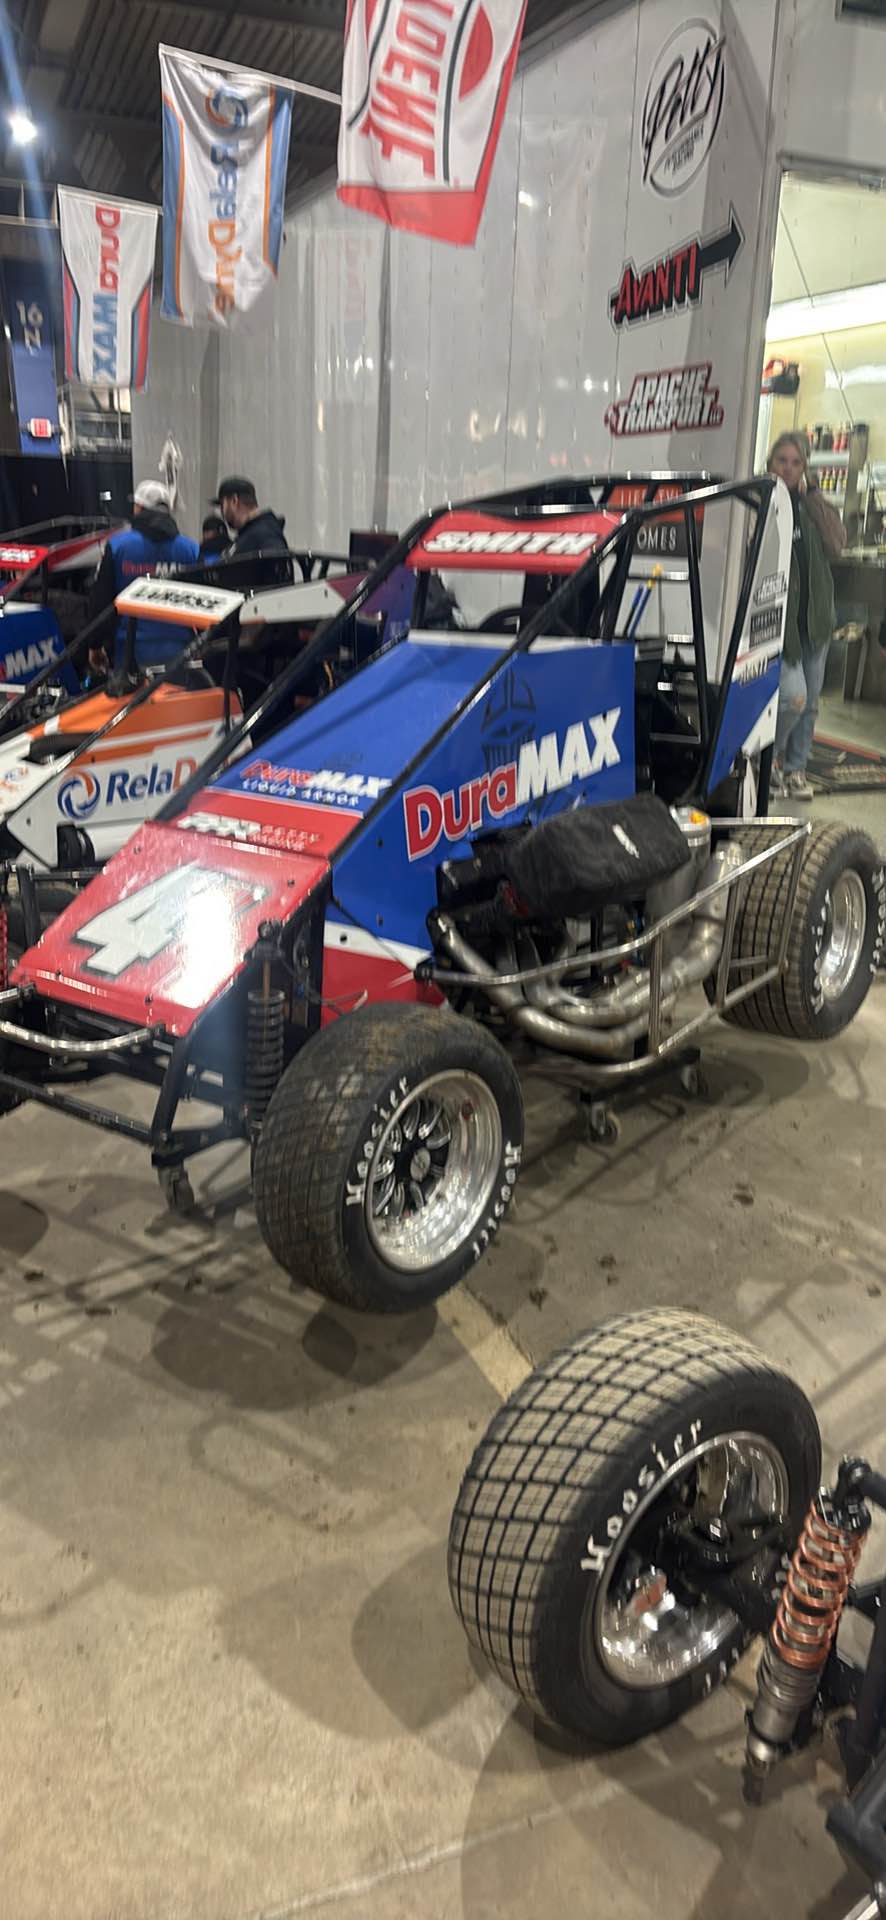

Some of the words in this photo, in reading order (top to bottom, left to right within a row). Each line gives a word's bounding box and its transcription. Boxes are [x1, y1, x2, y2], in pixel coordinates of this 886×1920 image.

[614, 241, 699, 323] AVANTI
[613, 393, 716, 433] TRANSPORT
[630, 365, 709, 406] APACHE
[425, 531, 598, 554] SMITH
[637, 526, 676, 550] OMES
[240, 759, 392, 797] DuraMAX
[403, 705, 621, 863] DuraMAX
[346, 1077, 409, 1206] Hoosier
[473, 1140, 522, 1260] Hoosier
[580, 1418, 702, 1570] Hoosier
